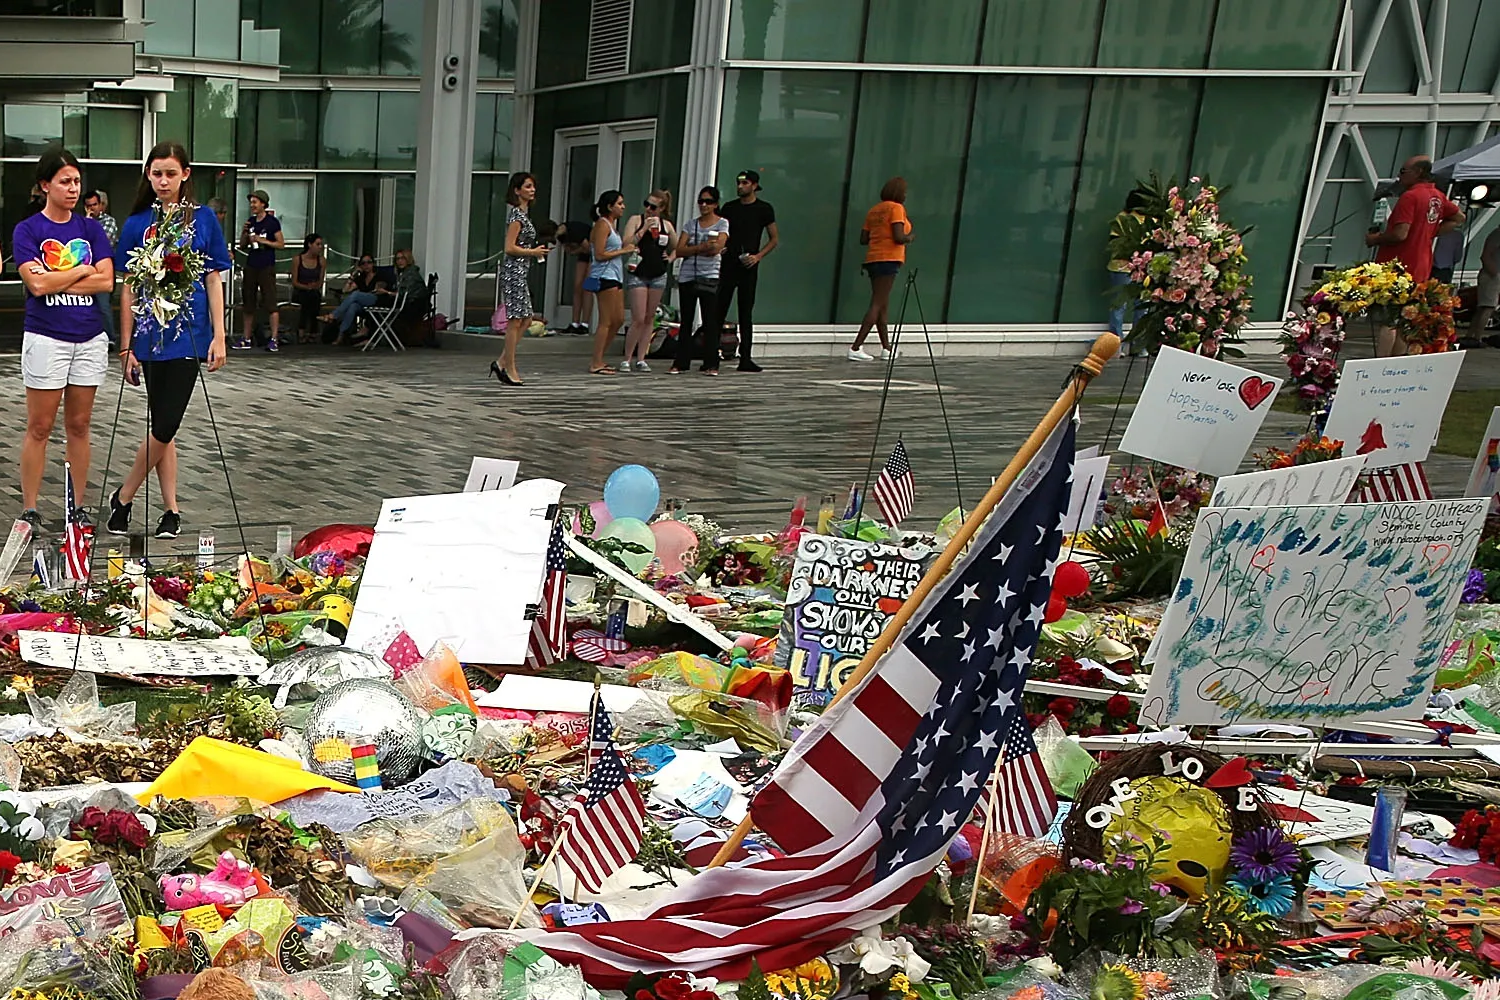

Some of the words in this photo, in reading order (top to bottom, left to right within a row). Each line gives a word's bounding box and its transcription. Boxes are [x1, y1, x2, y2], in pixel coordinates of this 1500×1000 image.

[45, 294, 94, 307] UNITED
[812, 561, 919, 599] DARKNES
[873, 559, 922, 581] THEIR
[835, 589, 880, 607] ONLY
[799, 601, 886, 639] SHOWS
[789, 648, 863, 693] LIG
